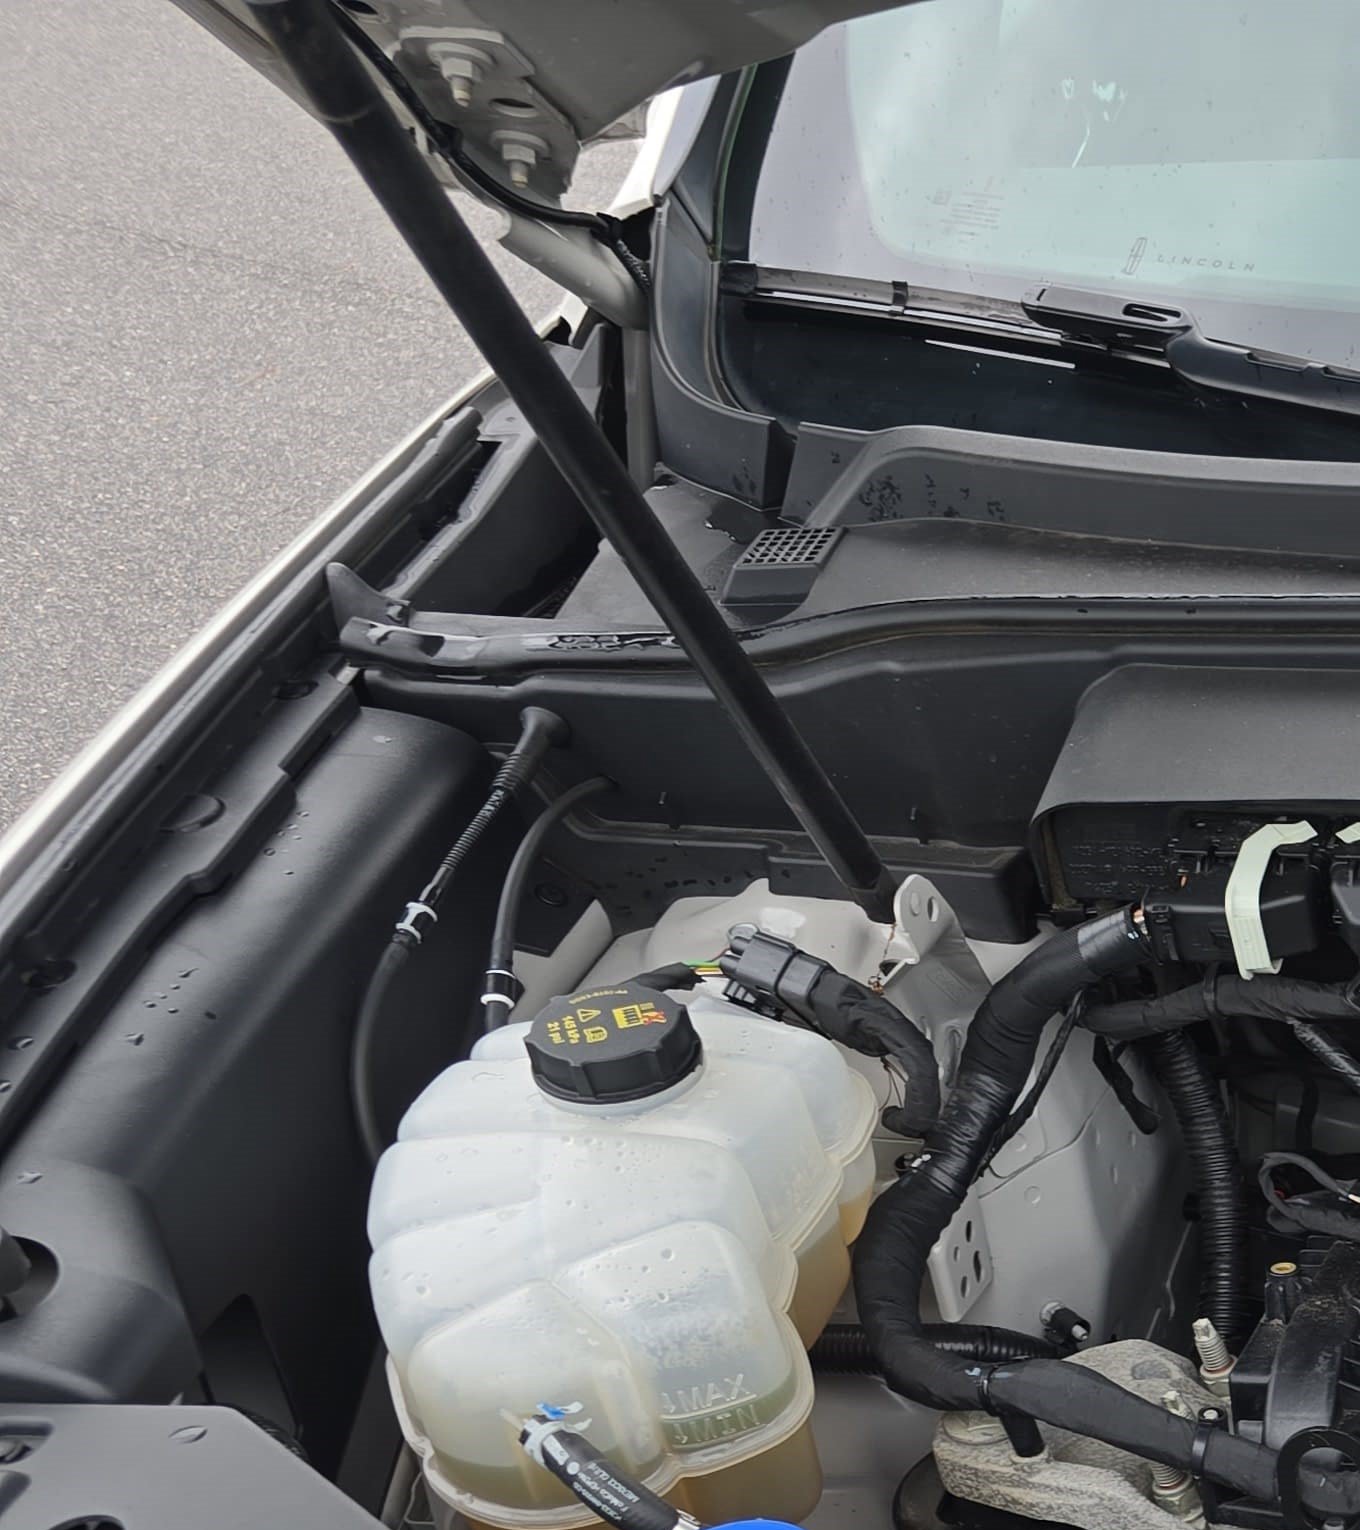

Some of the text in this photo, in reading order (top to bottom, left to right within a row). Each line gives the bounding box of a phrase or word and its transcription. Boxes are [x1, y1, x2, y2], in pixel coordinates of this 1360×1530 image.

[1157, 253, 1256, 273] LINCOLN
[677, 1374, 751, 1411] MAX
[694, 1404, 762, 1442] MIN
